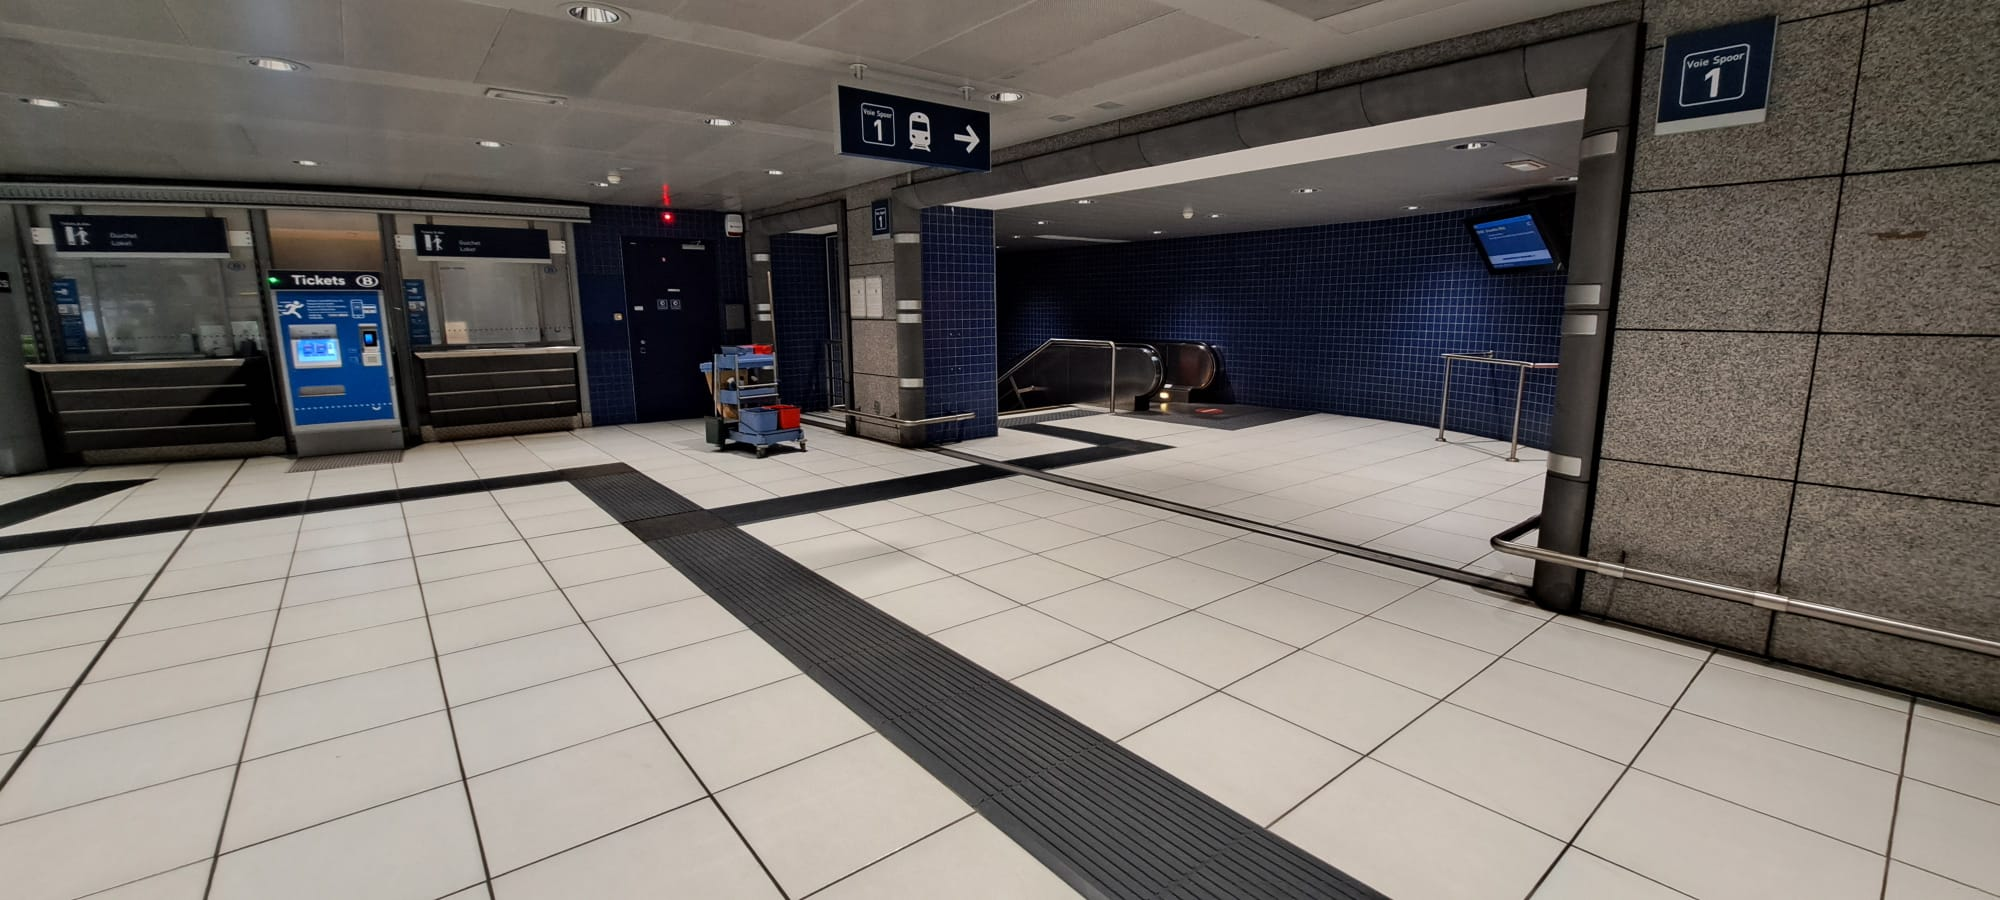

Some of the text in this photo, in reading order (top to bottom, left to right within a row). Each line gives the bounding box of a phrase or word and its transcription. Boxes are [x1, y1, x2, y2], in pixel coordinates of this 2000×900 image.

[1687, 52, 1745, 69] Voie Spoor
[1704, 67, 1720, 98] 1
[873, 119, 883, 142] 1
[878, 215, 883, 228] 1
[291, 274, 346, 286] Tickets
